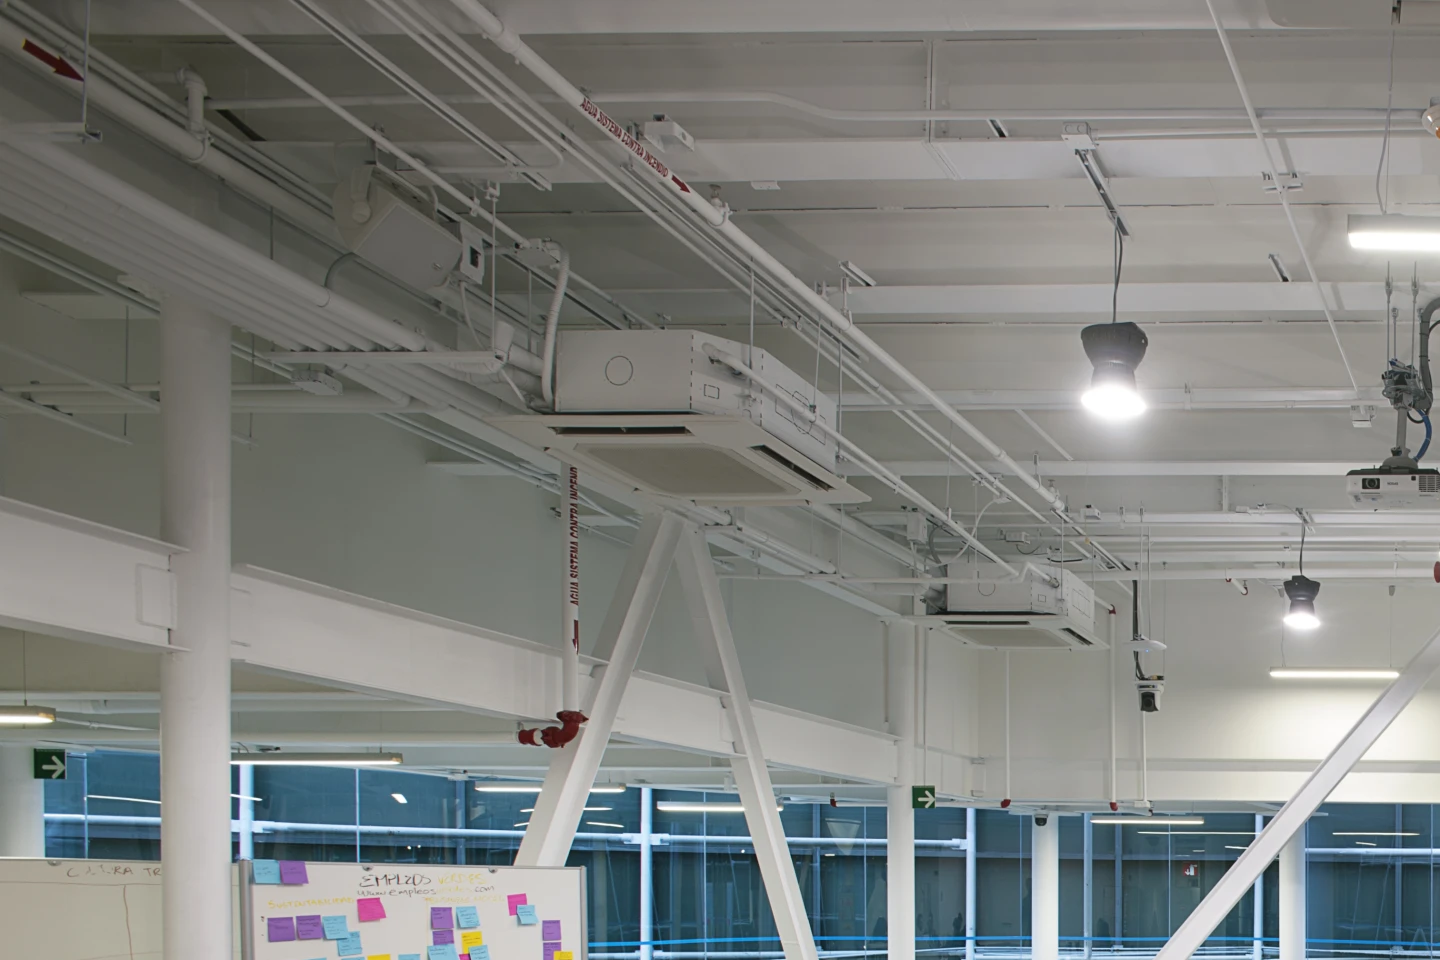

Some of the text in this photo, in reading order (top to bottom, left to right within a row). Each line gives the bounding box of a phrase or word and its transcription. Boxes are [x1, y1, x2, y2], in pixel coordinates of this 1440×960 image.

[580, 97, 669, 177] AGUA SISTEMA CONTRA INCENDIO
[569, 466, 579, 501] INCEND
[570, 503, 579, 538] CONTRA
[570, 541, 579, 579] SISTEMA
